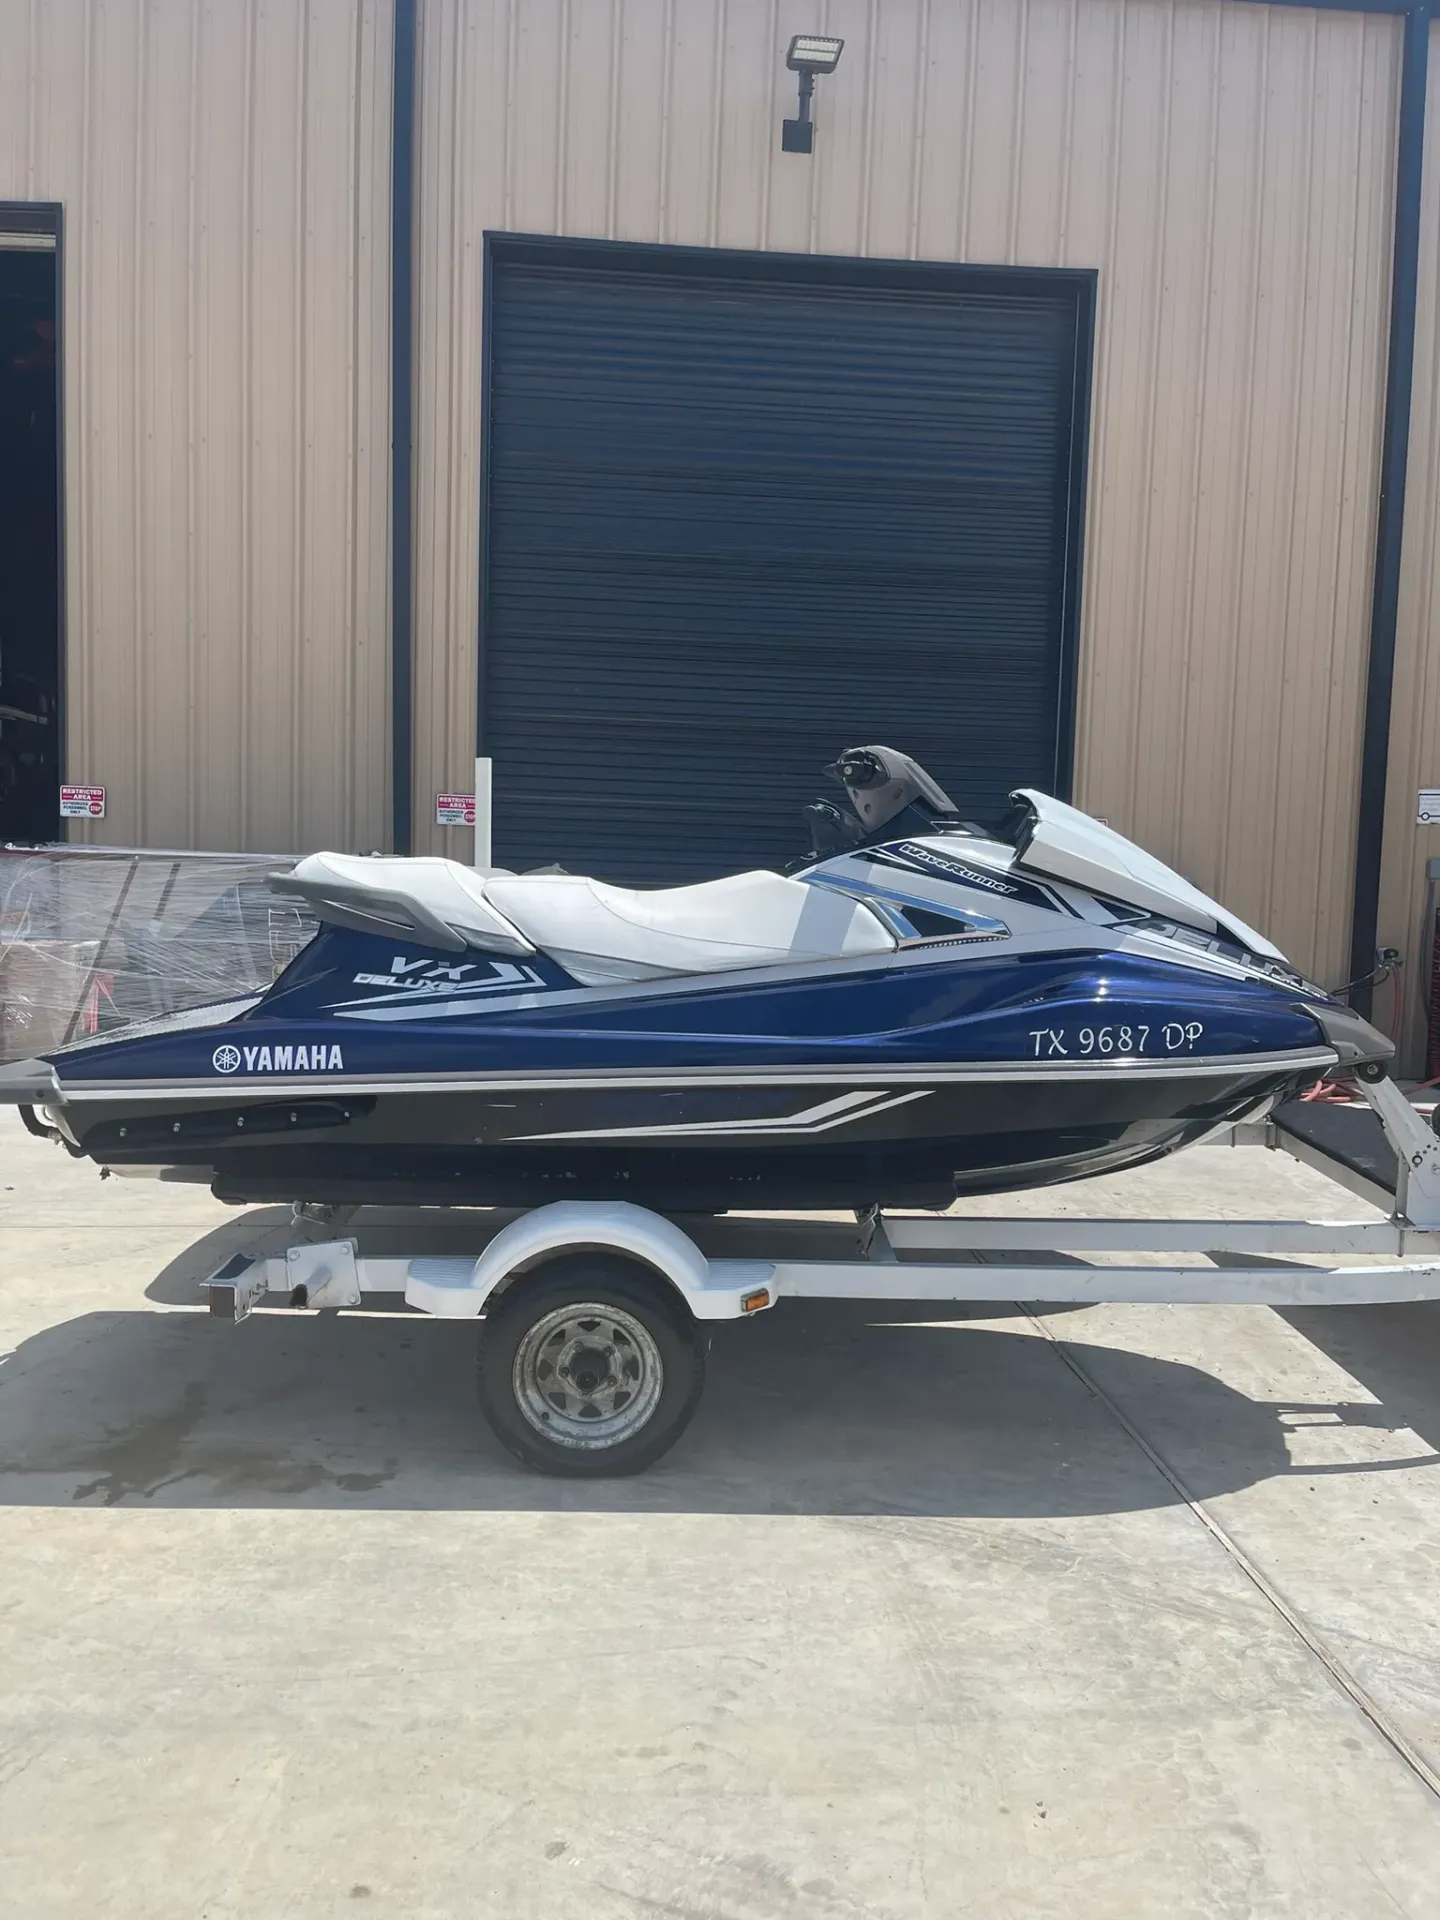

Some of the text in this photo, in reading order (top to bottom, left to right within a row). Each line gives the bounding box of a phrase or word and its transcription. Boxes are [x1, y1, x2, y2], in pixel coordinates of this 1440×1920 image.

[899, 843, 1019, 894] WaveRunner
[390, 956, 478, 981] VX
[352, 972, 460, 993] DELUXE
[1029, 1021, 1204, 1056] TX 9687 DP
[243, 1045, 344, 1071] YAMAHA
